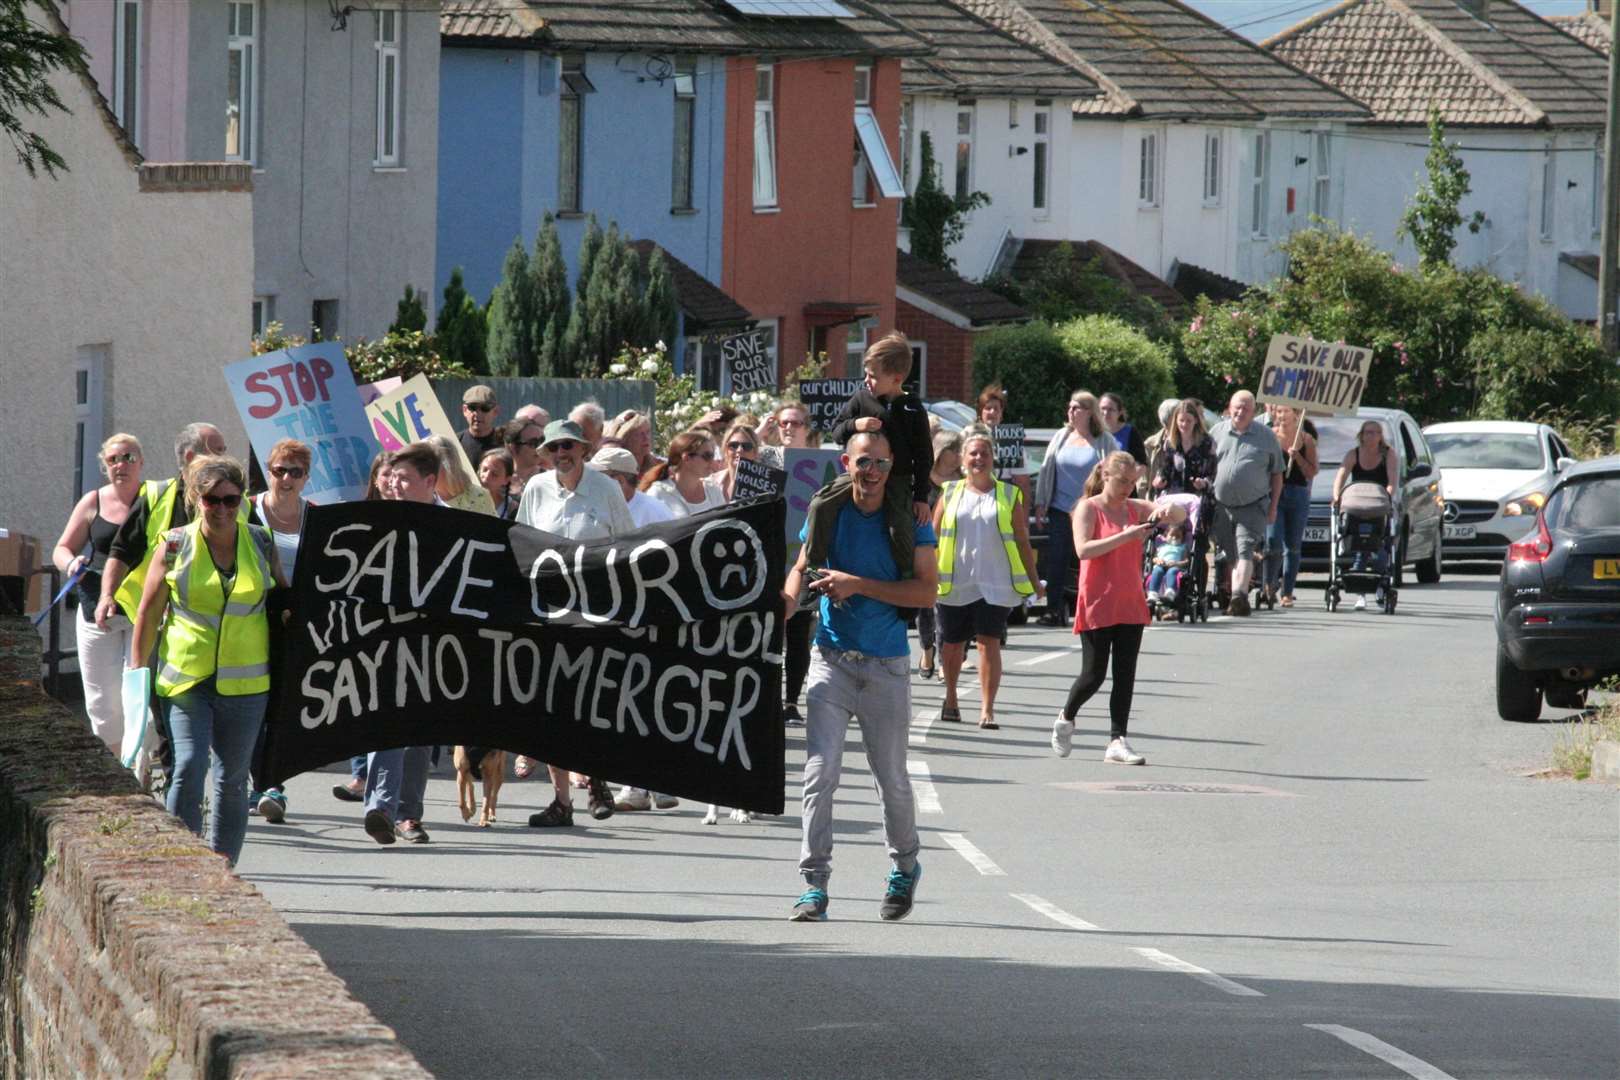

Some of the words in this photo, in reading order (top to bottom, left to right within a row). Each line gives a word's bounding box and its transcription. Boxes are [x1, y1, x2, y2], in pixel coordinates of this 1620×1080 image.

[723, 333, 763, 360] SAVE
[735, 355, 765, 371] OUR
[1281, 341, 1330, 367] SAVE
[1333, 349, 1365, 373] OUR
[245, 358, 335, 419] STOP
[1263, 365, 1363, 409] COMMUNITY!
[273, 403, 338, 438] THE
[314, 523, 506, 619] SAVE
[529, 538, 697, 629] OUR
[300, 640, 390, 729] SAY
[395, 634, 470, 708] NO
[478, 628, 541, 706] TO
[546, 642, 761, 771] MERGER
